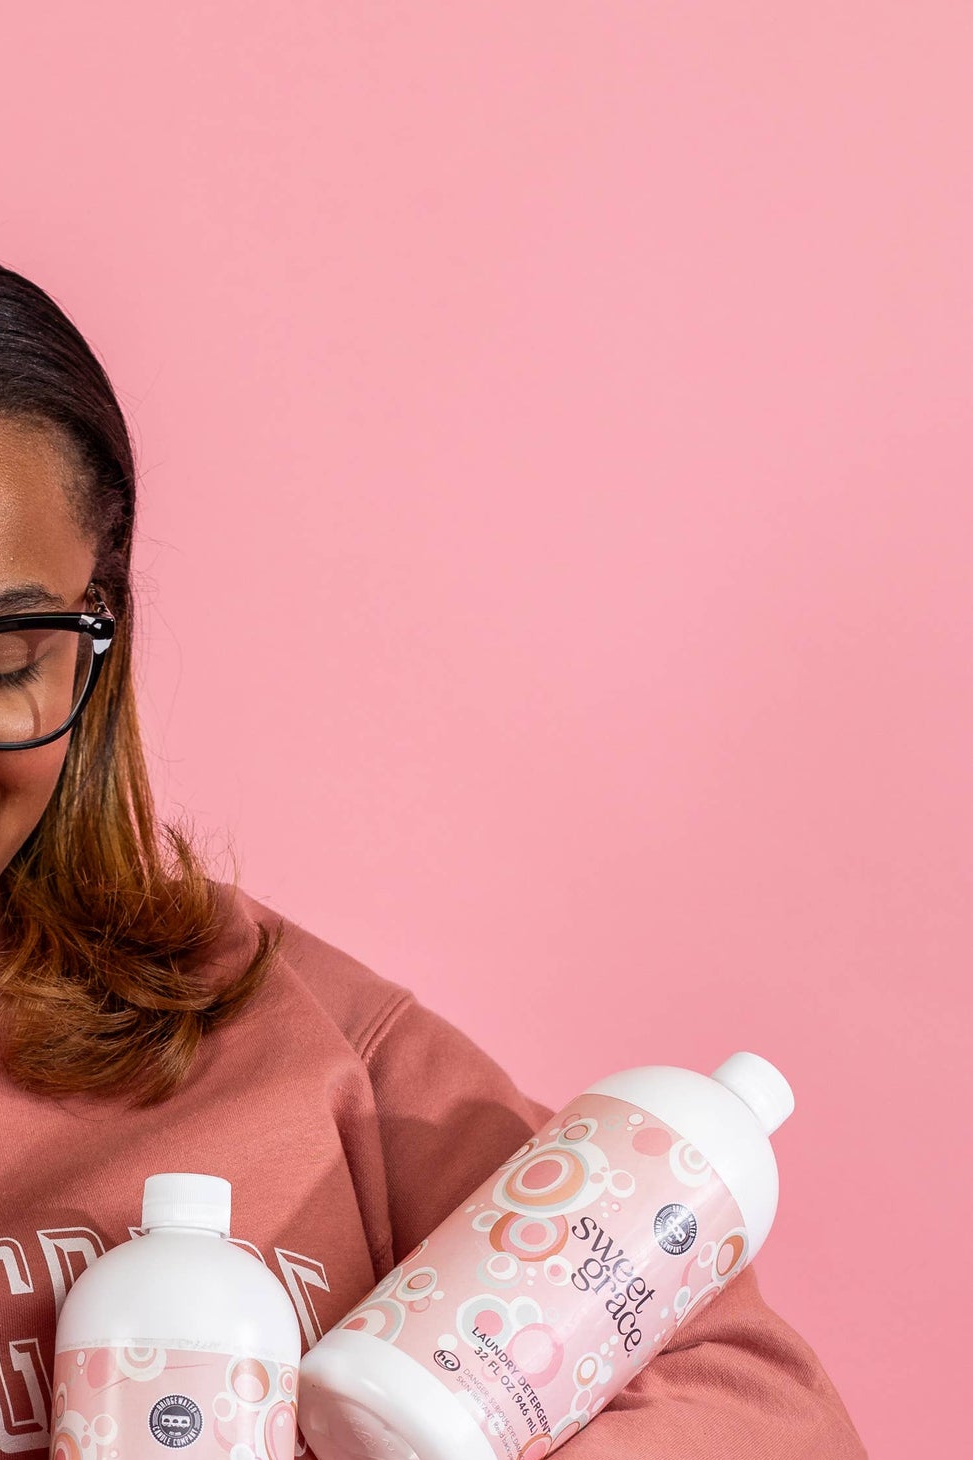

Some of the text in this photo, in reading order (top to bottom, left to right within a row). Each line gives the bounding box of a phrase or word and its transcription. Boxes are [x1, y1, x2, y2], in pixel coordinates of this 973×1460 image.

[571, 1216, 656, 1314] sweet
[156, 1396, 197, 1413] BRIDGEWATER
[471, 1326, 551, 1435] LAUNDRY DETERGENT
[473, 1346, 538, 1436] 32 FL OZ (946 mL)
[152, 1425, 198, 1447] CANDLE COMPANY
